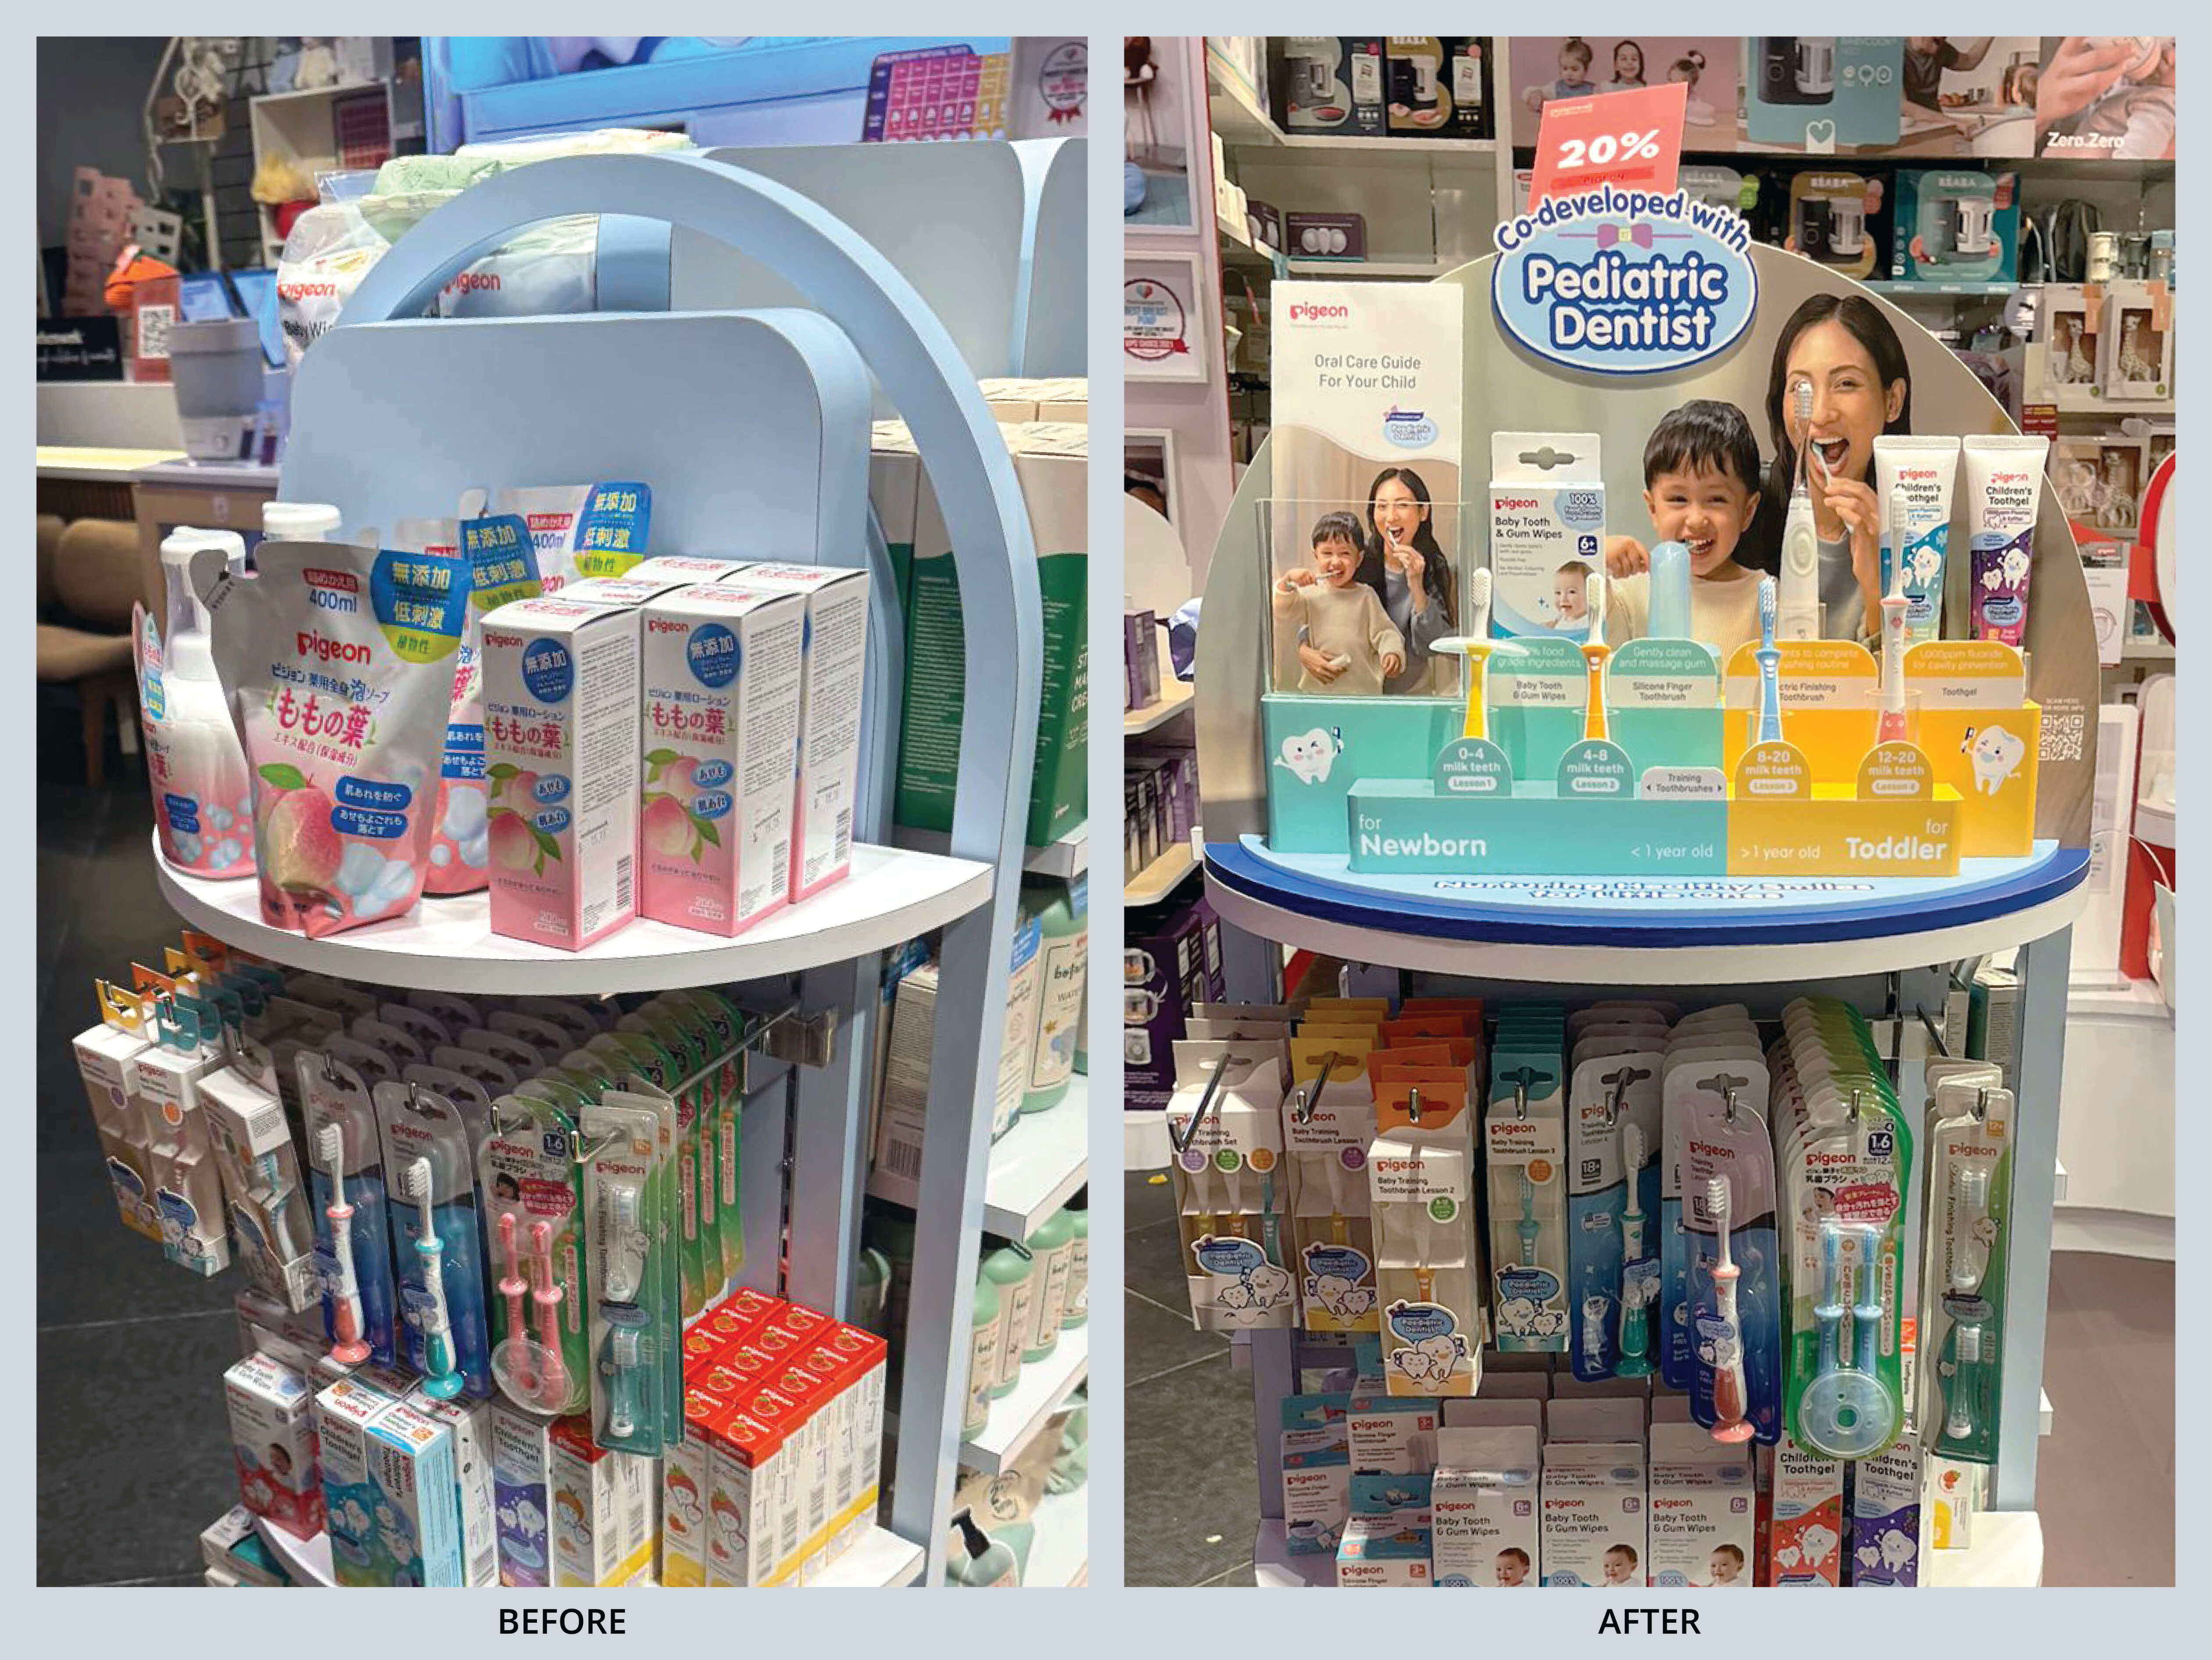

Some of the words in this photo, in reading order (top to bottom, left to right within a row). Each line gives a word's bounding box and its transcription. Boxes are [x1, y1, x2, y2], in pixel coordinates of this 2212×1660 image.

[2047, 132, 2126, 150] Zero.Zero
[1556, 129, 1660, 169] 20%
[1497, 184, 1685, 251] Co-developed
[1692, 204, 1749, 252] with
[1526, 255, 1723, 301] Pediatric
[1554, 303, 1709, 345] Dentist
[1314, 354, 1342, 368] Oral
[1346, 354, 1378, 369] Care
[1381, 355, 1421, 369] Guide
[1319, 374, 1342, 387] For
[1345, 374, 1378, 388] Your
[1381, 375, 1417, 389] Child
[1986, 486, 2033, 496] Children's
[1989, 497, 2030, 506] Toothgel
[1495, 516, 1520, 528] Baby
[1522, 516, 1550, 527] Tooth
[1496, 529, 1504, 538] &
[1506, 529, 1530, 538] Gum
[1532, 529, 1562, 540] Wipes
[308, 589, 358, 613] 400ml
[1634, 646, 1661, 658] Gently
[1662, 647, 1692, 657] clean
[1619, 658, 1635, 668] and
[1636, 659, 1685, 669] massage
[1687, 660, 1707, 669] gum
[1958, 661, 2008, 671] prevention
[1517, 681, 1536, 692] Baby
[1539, 681, 1563, 690] Tooth
[1632, 682, 1665, 691] Silicone
[1667, 681, 1693, 692] Finger
[1800, 682, 1836, 692] Finishing
[1942, 687, 1977, 697] Toothgel
[1520, 692, 1539, 700] Gum
[1541, 692, 1566, 702] Wipes
[1639, 692, 1686, 701] Toothbrush
[1779, 692, 1825, 702] Toothbrush
[278, 687, 371, 750] ももの葉
[652, 702, 727, 734] ももの葉
[491, 716, 562, 749] ももの葉
[1459, 747, 1484, 760] 0-4
[1583, 749, 1608, 761] 4-8
[1757, 751, 1790, 763] 8-20
[1877, 751, 1917, 764] 12-20
[1443, 761, 1469, 772] milk
[1470, 762, 1501, 773] teeth
[1567, 763, 1593, 774] milk
[1594, 763, 1623, 774] teeth
[1745, 765, 1771, 775] milk
[1772, 765, 1801, 776] teeth
[1868, 765, 1893, 776] milk
[1895, 766, 1925, 776] teeth
[1668, 773, 1701, 784] Training
[1656, 783, 1714, 793] Toothbrushes
[1359, 813, 1382, 831] for
[1926, 817, 1949, 834] for
[1360, 832, 1488, 857] Newborn
[1845, 836, 1947, 860] Toddler
[1655, 845, 1687, 860] year
[1690, 844, 1713, 858] old
[1763, 846, 1794, 861] year
[1798, 845, 1820, 859] old
[1421, 1186, 1448, 1194] Lesson
[1784, 1464, 1835, 1475] Toothgel
[1864, 1462, 1914, 1481] Toothgel
[1436, 1517, 1460, 1527] Baby
[1463, 1517, 1491, 1526] Tooth
[1545, 1513, 1568, 1524] Baby
[1571, 1513, 1599, 1523] Tooth
[1653, 1513, 1676, 1524] Baby
[1679, 1513, 1707, 1523] Tooth
[1445, 1527, 1469, 1536] Gum
[1471, 1527, 1500, 1538] Wipes
[1555, 1524, 1578, 1533] Gum
[1579, 1524, 1609, 1534] Wipes
[1662, 1524, 1685, 1533] Gum
[1687, 1524, 1716, 1534] Wipes
